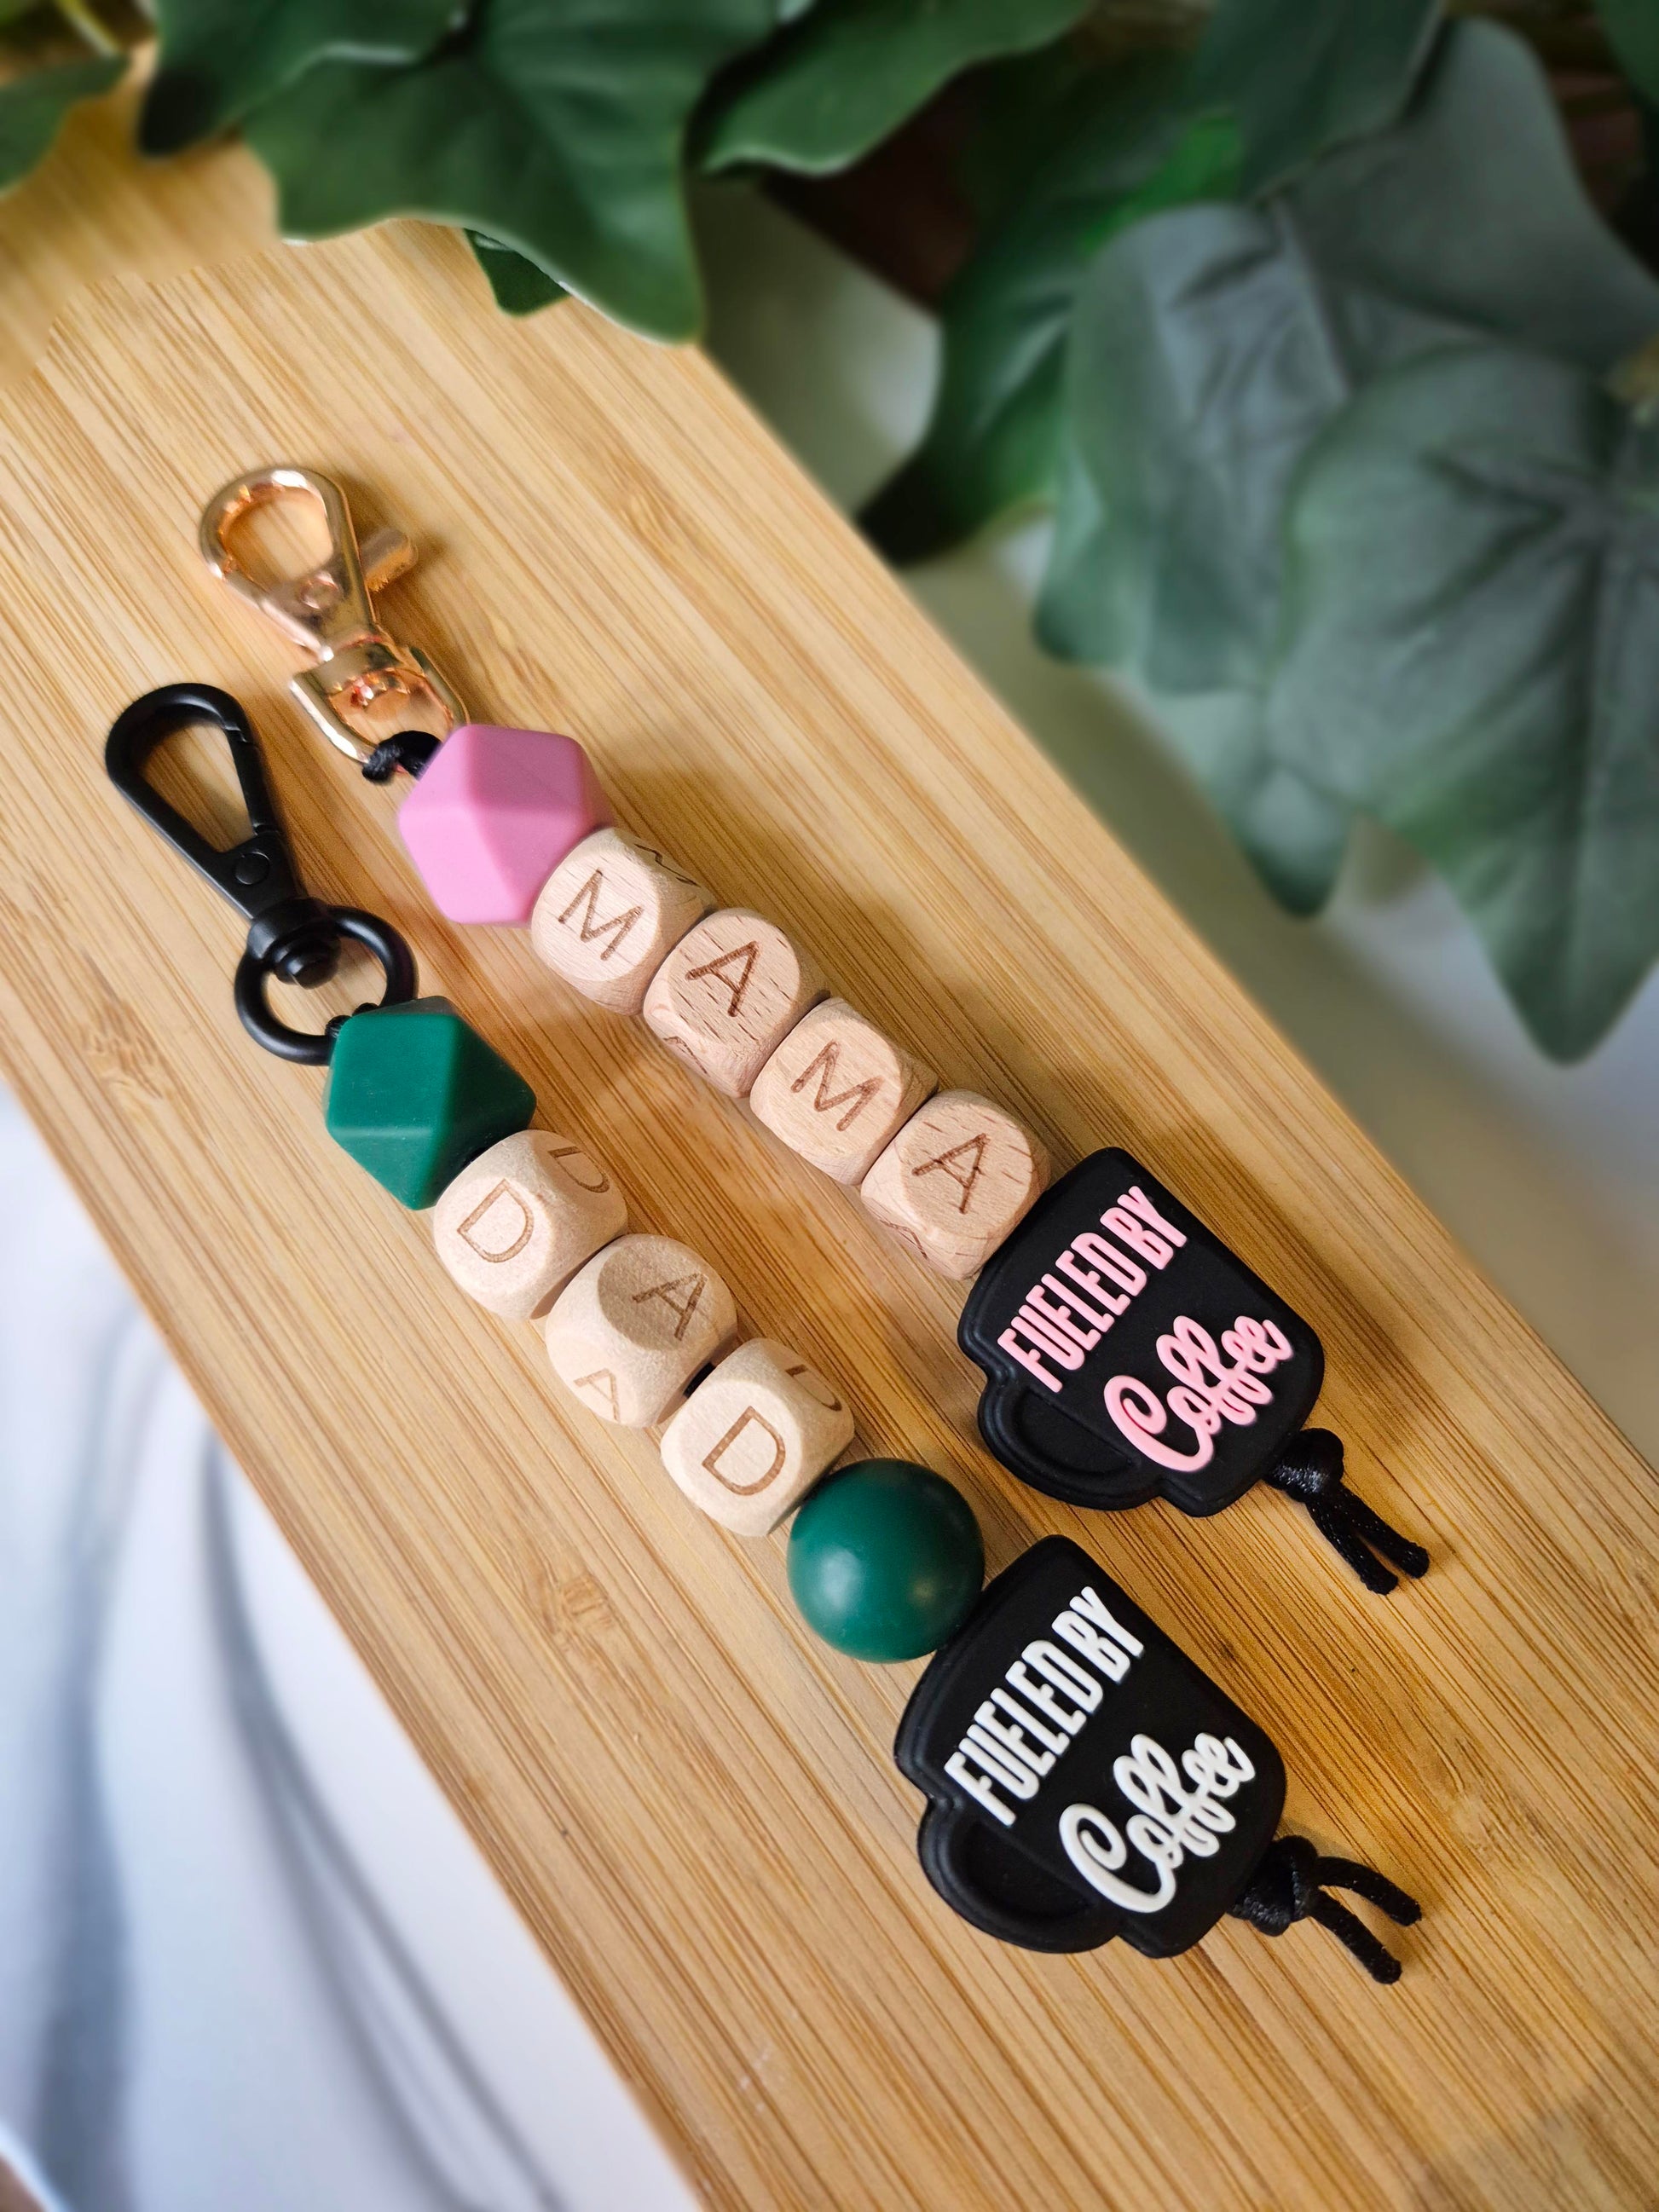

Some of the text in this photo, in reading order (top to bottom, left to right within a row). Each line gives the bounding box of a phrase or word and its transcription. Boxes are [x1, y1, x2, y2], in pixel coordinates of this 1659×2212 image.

[558, 869, 990, 1215] MAMA
[457, 1179, 786, 1496] DAD
[997, 1186, 1187, 1393] FUELED BY
[1103, 1315, 1294, 1472] Coffee
[944, 1586, 1144, 1827] FUELED BY
[1059, 1732, 1256, 1914] Coffee
